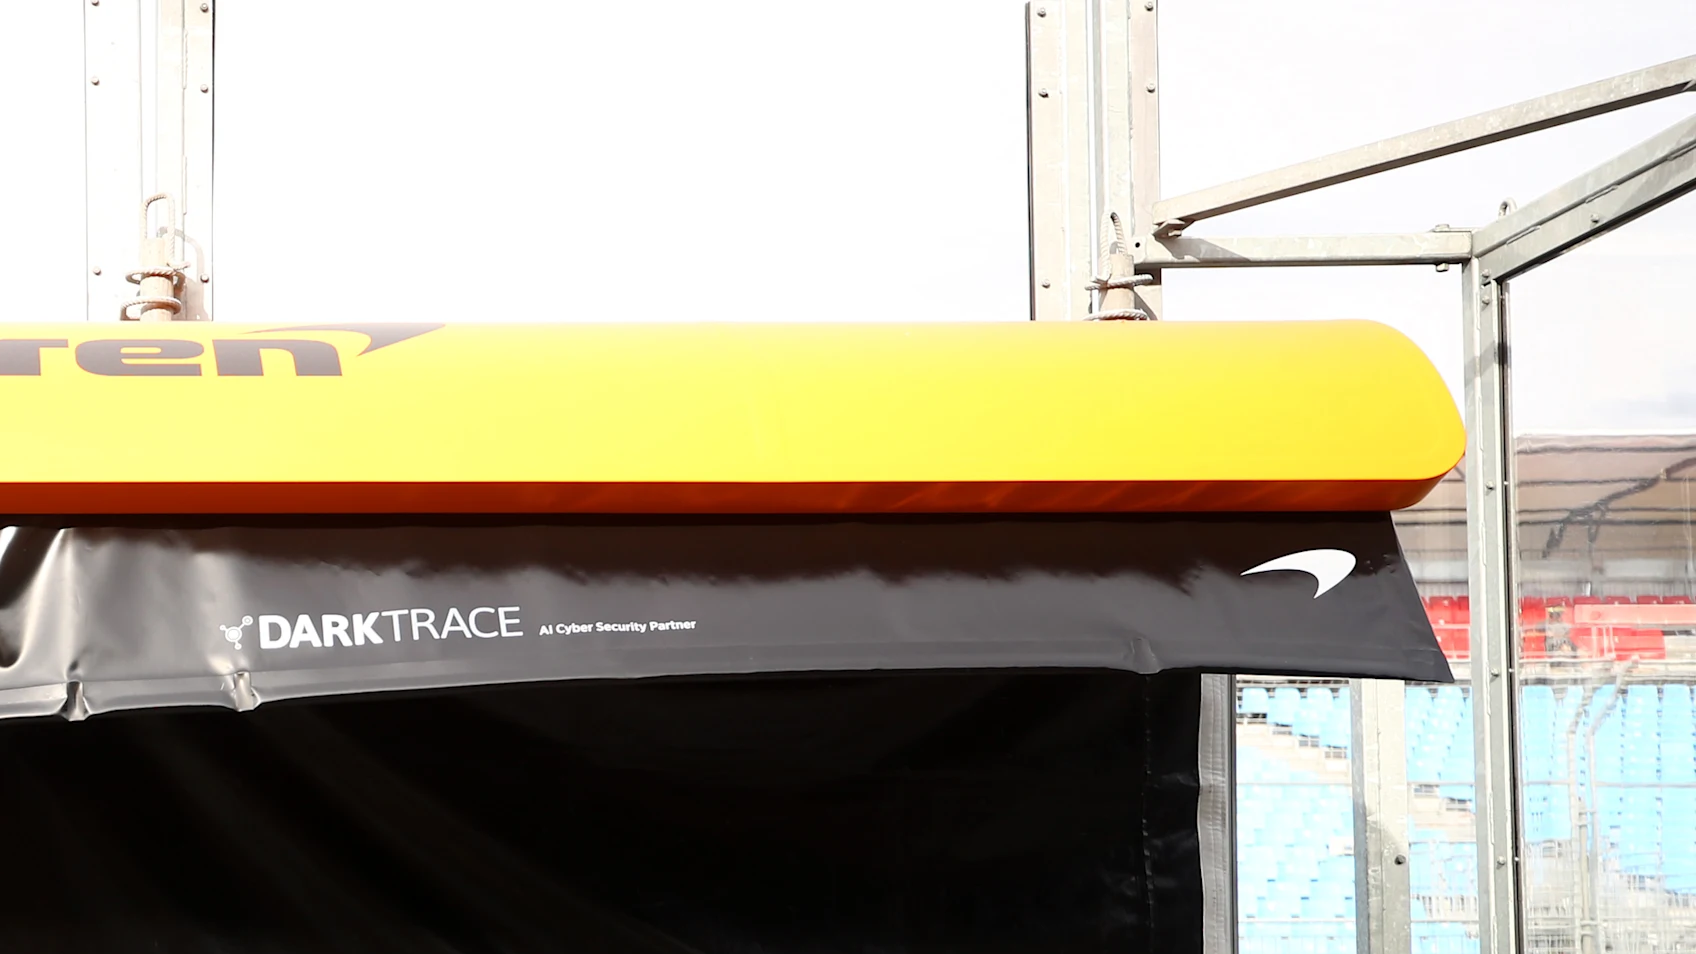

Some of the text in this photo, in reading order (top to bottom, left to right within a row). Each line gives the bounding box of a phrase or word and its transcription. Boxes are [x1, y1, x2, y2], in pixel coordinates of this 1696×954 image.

[257, 605, 696, 649] DARKTRACE AI Cyber Security Partner
